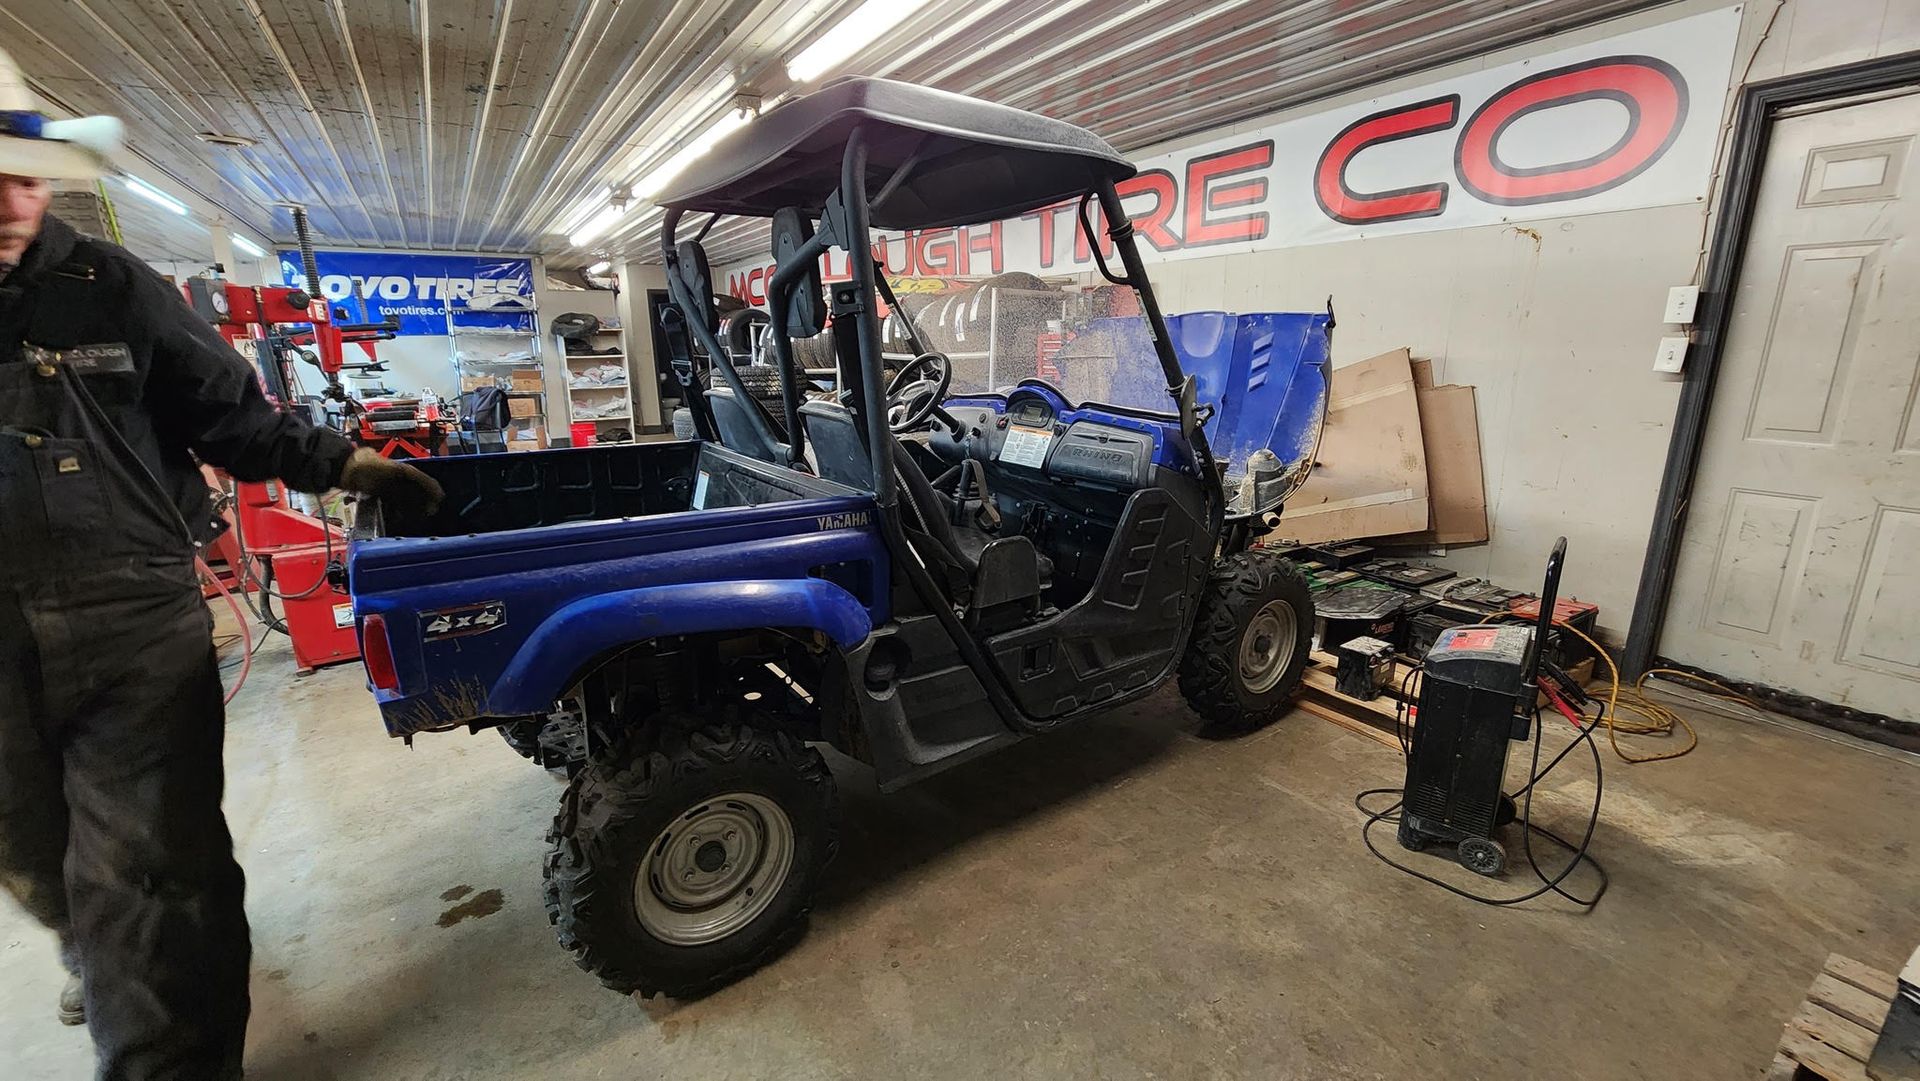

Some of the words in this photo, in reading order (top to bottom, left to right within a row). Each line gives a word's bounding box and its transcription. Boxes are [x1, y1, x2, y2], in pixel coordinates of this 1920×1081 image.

[1021, 138, 1274, 268] TIRE
[1314, 55, 1690, 226] CO
[413, 276, 521, 302] TIRES
[1071, 447, 1123, 464] RHINO
[816, 510, 869, 532] YAMAHA
